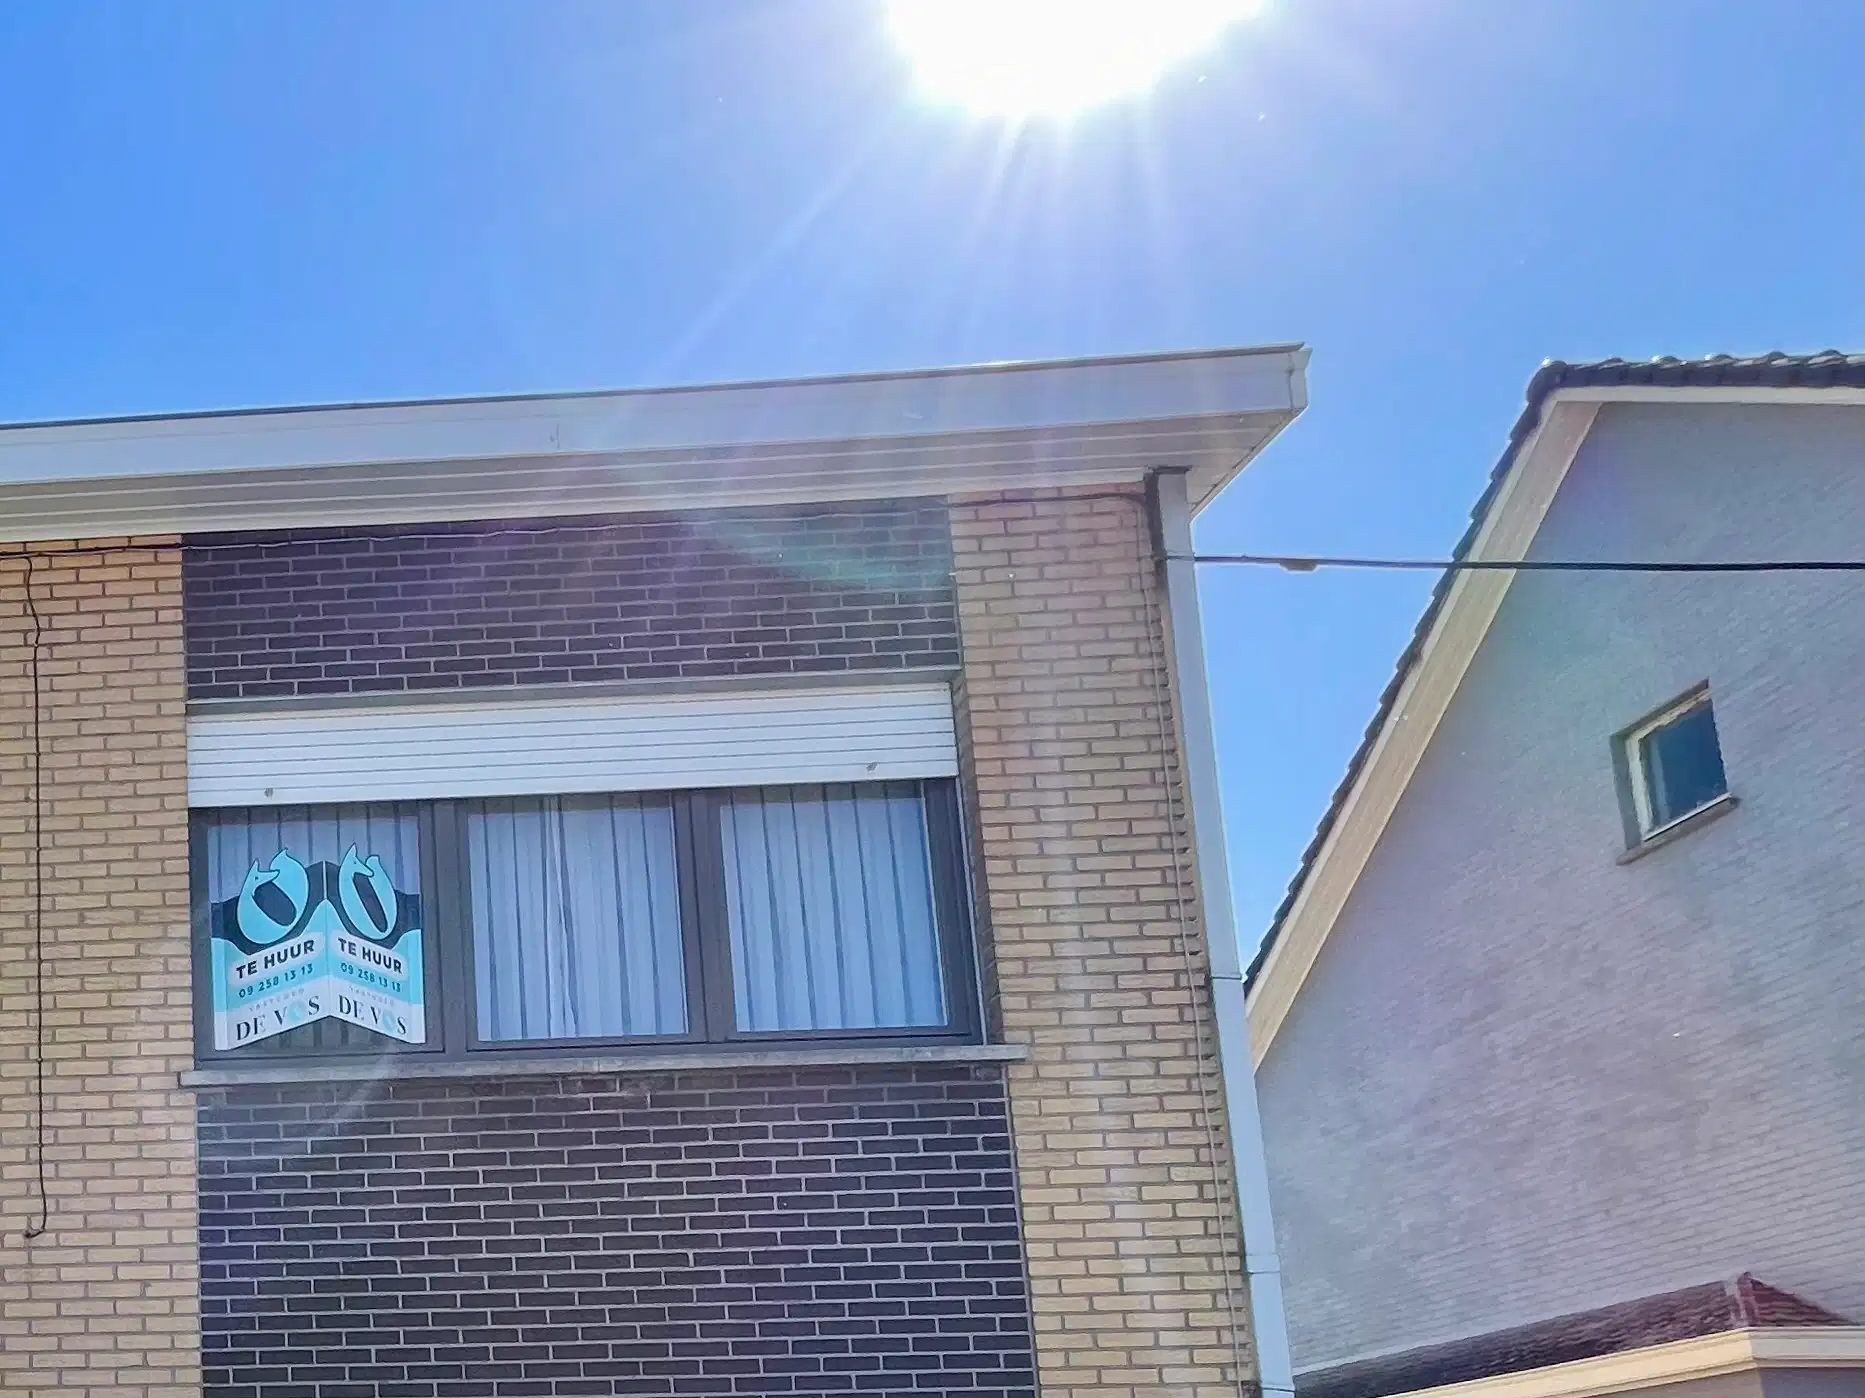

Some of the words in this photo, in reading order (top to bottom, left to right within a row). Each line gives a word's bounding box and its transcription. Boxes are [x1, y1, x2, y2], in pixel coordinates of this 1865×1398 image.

[236, 960, 258, 979] TE
[264, 940, 315, 969] HUUR
[338, 938, 357, 956] TE
[362, 946, 402, 974] HUUR
[238, 985, 254, 998] 09
[258, 976, 279, 992] 258
[284, 970, 296, 982] 13
[301, 963, 313, 976] 13
[340, 962, 354, 975] 09
[357, 968, 375, 983] 258
[378, 976, 388, 988] 13
[391, 981, 401, 993] 13
[339, 994, 365, 1021] DE
[236, 1014, 266, 1040] DE
